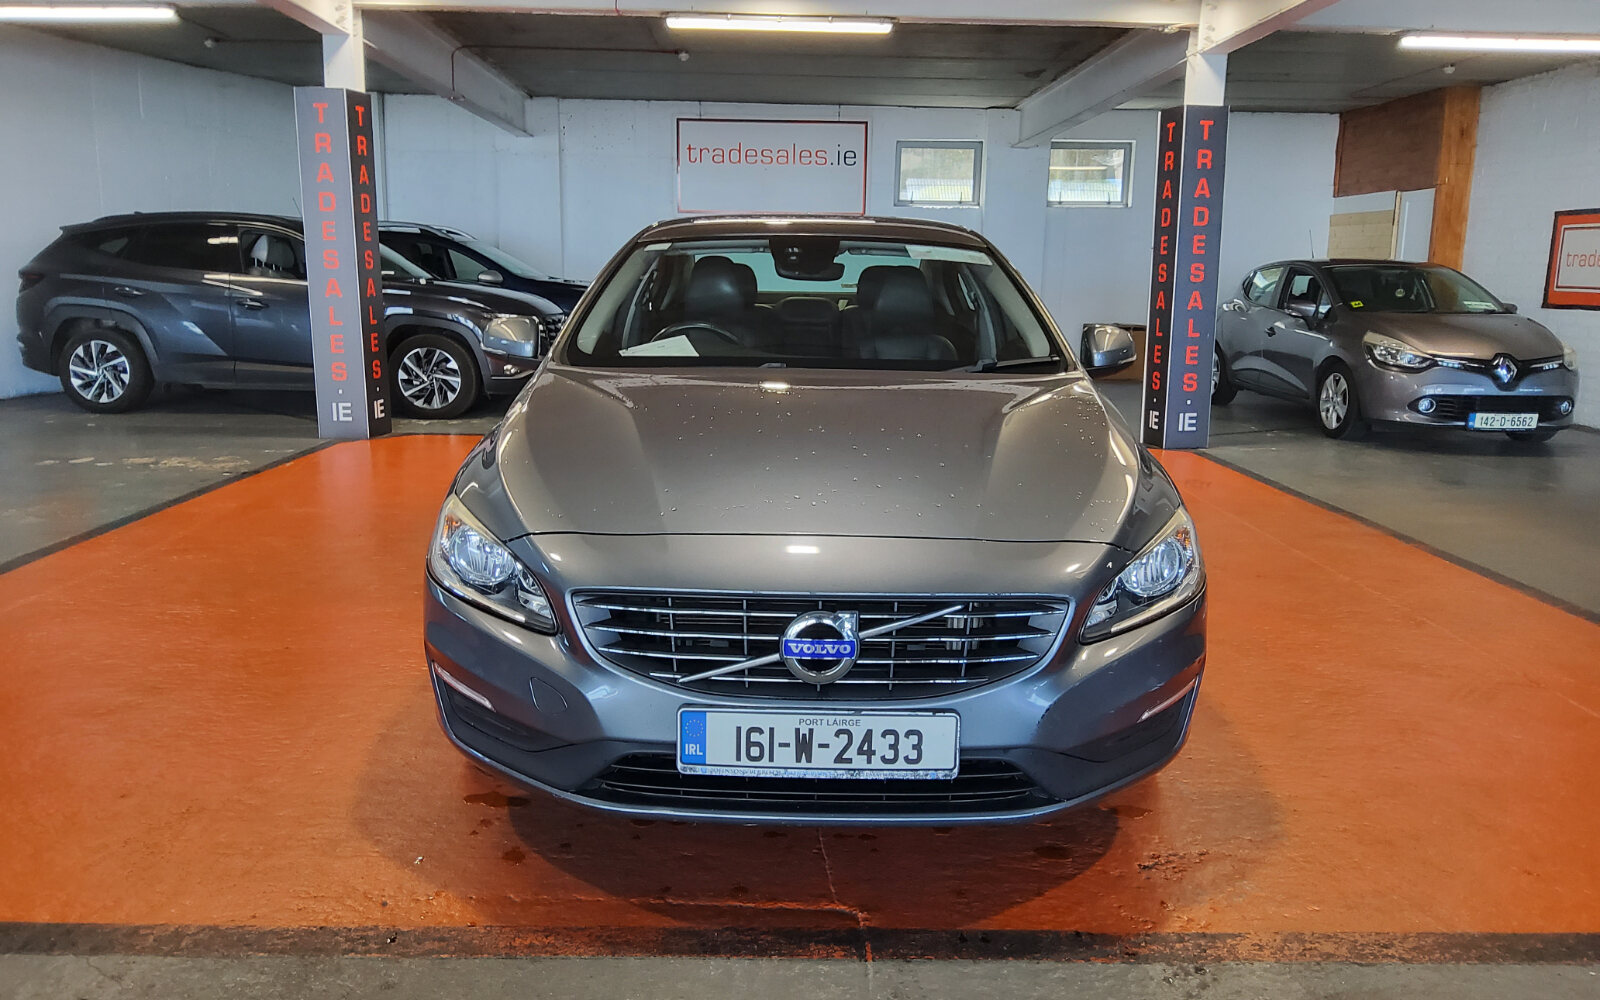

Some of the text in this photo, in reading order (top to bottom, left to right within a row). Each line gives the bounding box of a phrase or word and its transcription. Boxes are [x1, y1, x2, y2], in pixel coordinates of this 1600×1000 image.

[686, 142, 857, 166] tradesales.ie
[1480, 416, 1534, 427] 142-D-6562
[788, 643, 851, 654] VOLVO
[798, 717, 861, 727] PORT LÁIRGE
[685, 743, 703, 756] IRL
[735, 726, 924, 765] 161-W-2433
